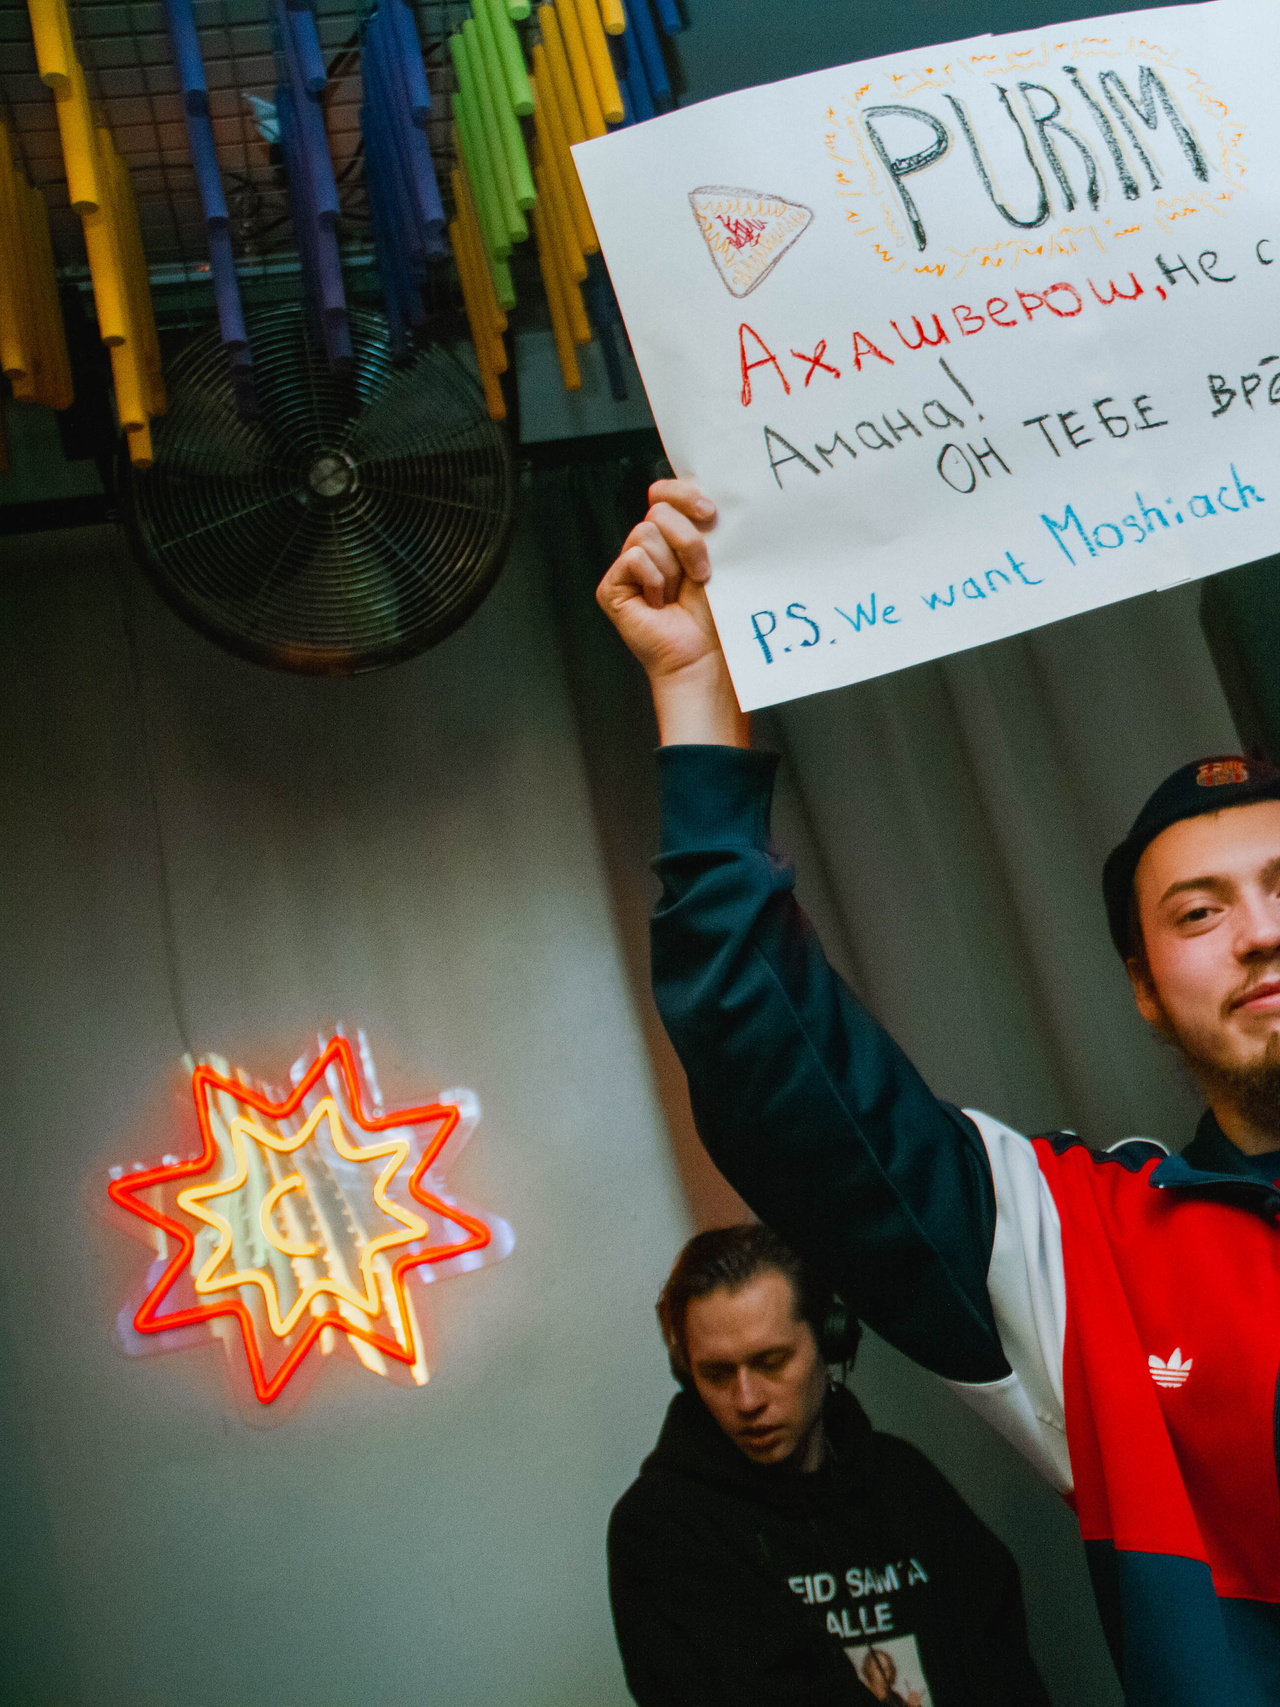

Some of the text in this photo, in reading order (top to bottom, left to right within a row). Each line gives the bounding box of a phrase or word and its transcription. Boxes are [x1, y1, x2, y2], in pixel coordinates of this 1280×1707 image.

[861, 65, 1210, 253] PURIM
[763, 357, 985, 490] Амана!
[1022, 394, 1169, 458] ТЕБЕ
[833, 592, 902, 633] We
[921, 550, 1045, 611] want
[1039, 463, 1267, 566] Moshiach
